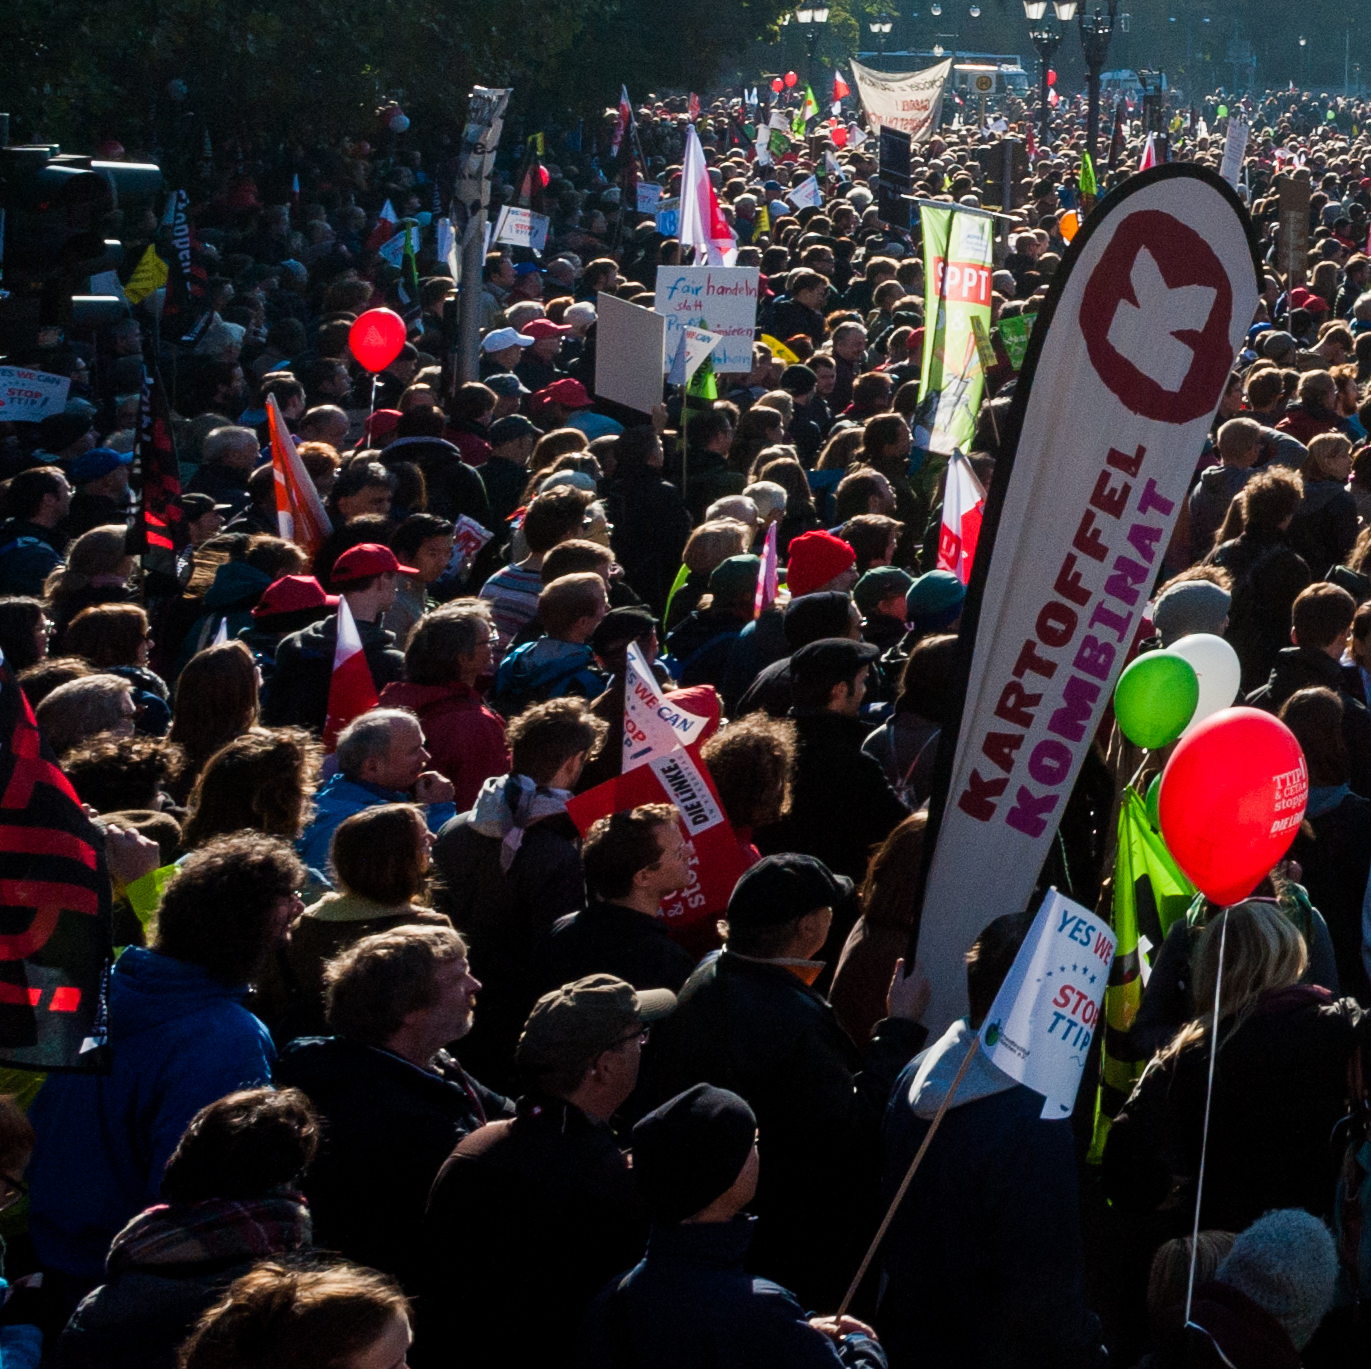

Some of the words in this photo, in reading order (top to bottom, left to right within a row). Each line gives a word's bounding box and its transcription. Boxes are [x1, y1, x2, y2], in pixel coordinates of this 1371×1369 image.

[666, 276, 703, 300] fair
[706, 272, 758, 298] handeln
[674, 299, 703, 311] statt
[6, 388, 43, 399] STOP
[957, 443, 1147, 822] KARTOFFEL
[1004, 477, 1175, 838] KOMBINAT
[633, 682, 659, 709] WE
[657, 706, 695, 733] CAN
[660, 758, 697, 803] LINKE.
[1274, 791, 1281, 800] &
[682, 800, 710, 826] DIE
[1057, 909, 1097, 947] YES
[1092, 931, 1114, 966] WE
[1047, 1011, 1091, 1052] TTIP
